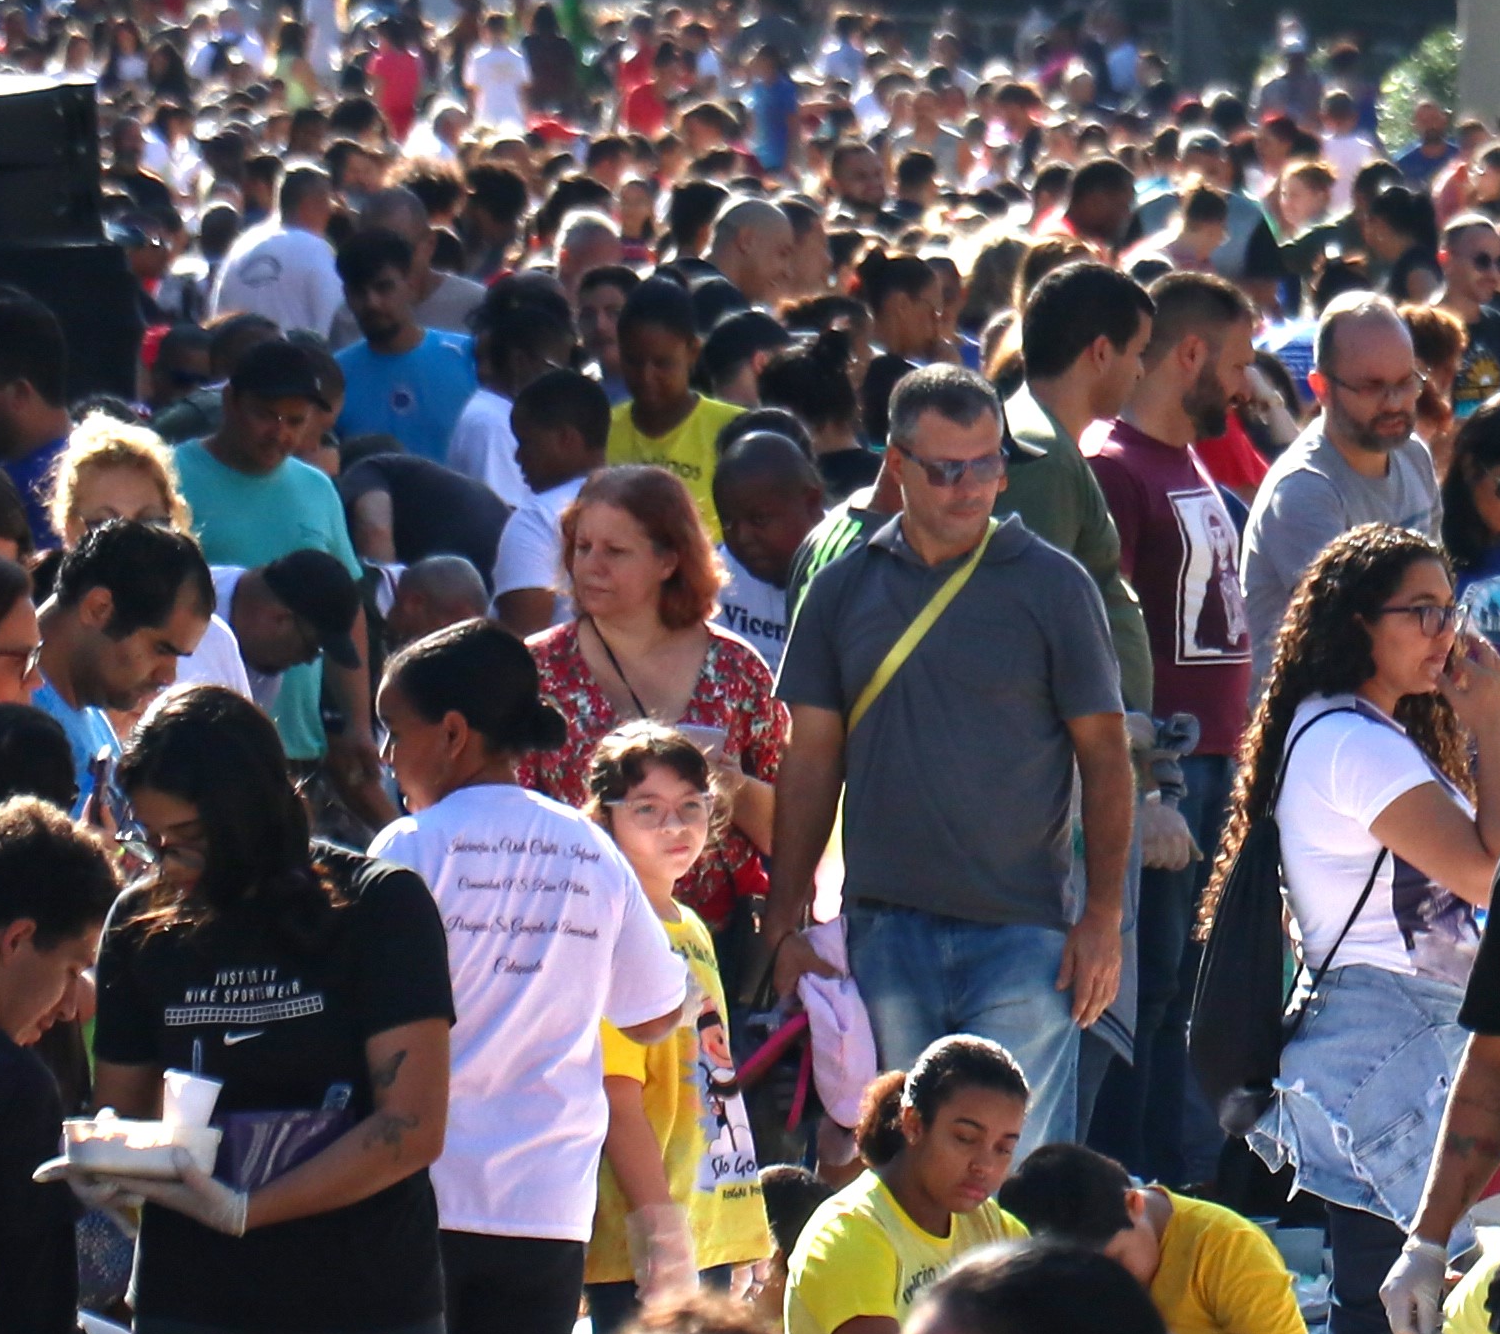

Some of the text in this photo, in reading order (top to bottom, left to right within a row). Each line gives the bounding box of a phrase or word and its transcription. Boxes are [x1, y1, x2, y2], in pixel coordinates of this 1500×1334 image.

[214, 970, 244, 987] JUST
[263, 969, 278, 983] IT
[185, 990, 217, 1004] NIKE
